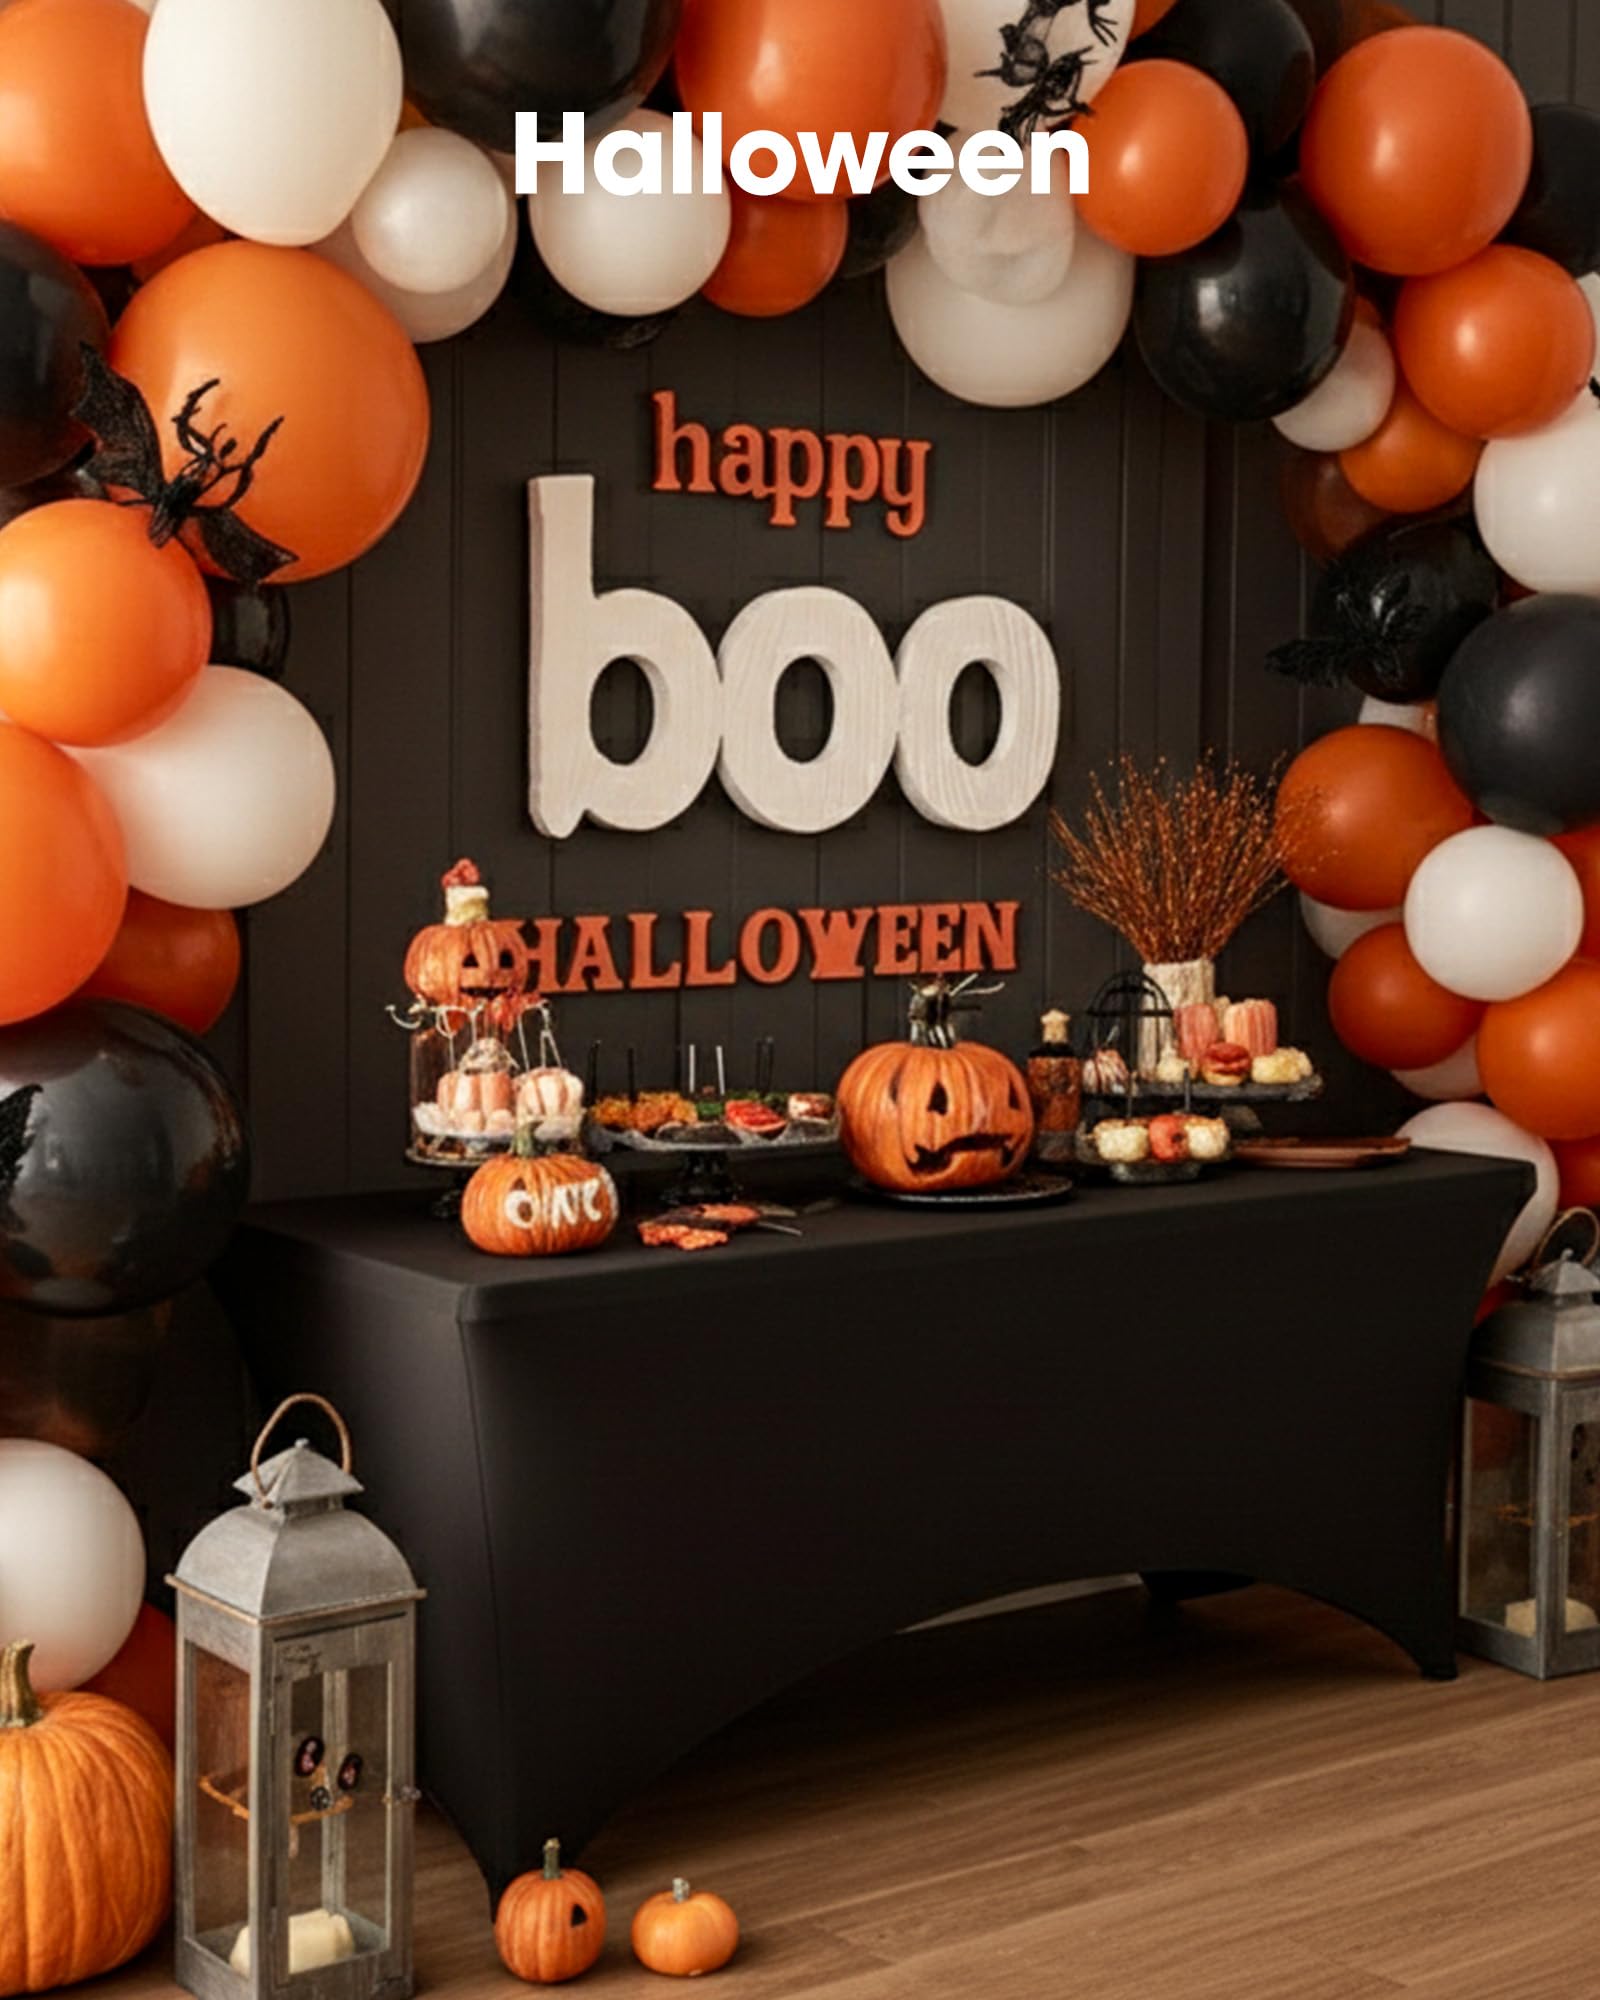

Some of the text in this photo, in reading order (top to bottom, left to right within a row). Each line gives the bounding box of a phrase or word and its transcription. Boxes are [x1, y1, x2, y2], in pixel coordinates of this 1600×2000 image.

[652, 391, 932, 537] happy
[528, 473, 1061, 839] boo
[490, 902, 1020, 992] HALLOWEEN
